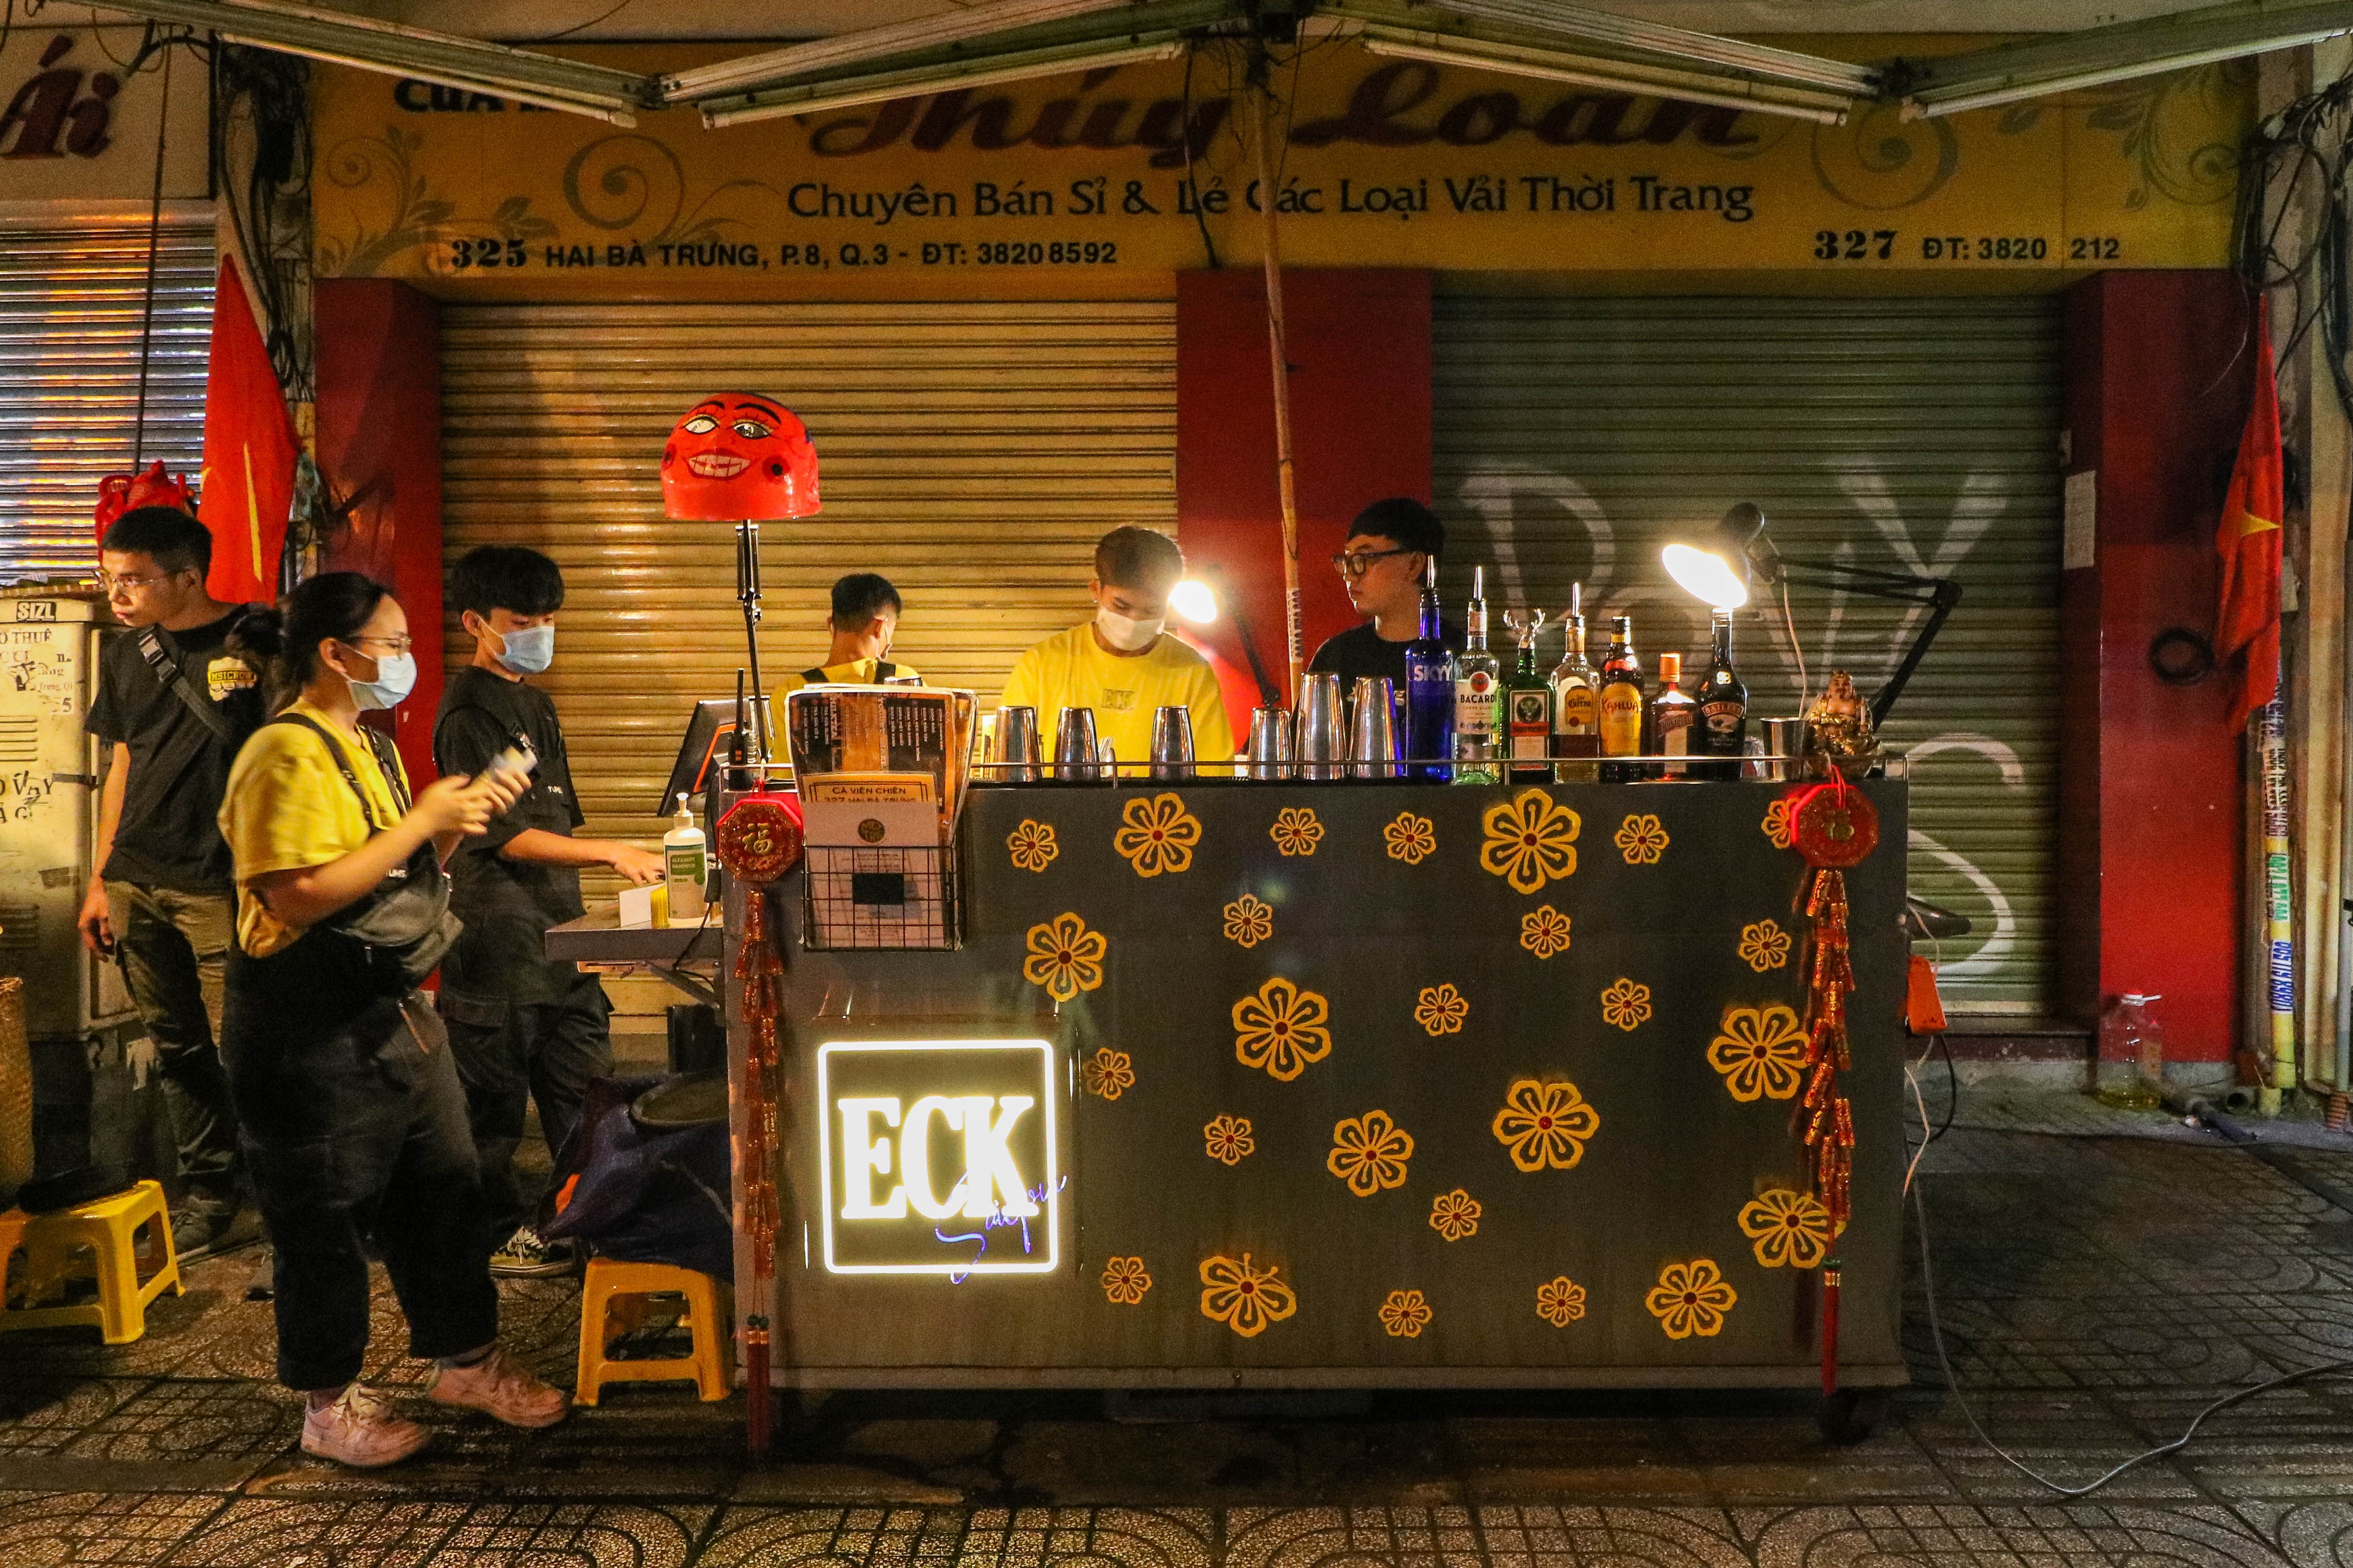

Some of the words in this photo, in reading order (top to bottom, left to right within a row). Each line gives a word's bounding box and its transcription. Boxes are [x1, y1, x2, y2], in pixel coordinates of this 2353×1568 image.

[789, 183, 957, 225] Chuyên
[975, 180, 1052, 216] Bán
[1069, 176, 1106, 215] Sỉ
[1123, 180, 1161, 215] &
[1177, 176, 1228, 214] Lẻ
[1340, 178, 1429, 220] Loại
[1444, 174, 1506, 213] Vải
[1520, 173, 1615, 213] Thời
[1629, 175, 1754, 223] Trang
[452, 238, 527, 268] 325
[546, 245, 594, 267] HAI
[607, 239, 646, 267] BÀ
[839, 243, 889, 267] Q.3
[921, 242, 967, 265] ĐT:
[1814, 230, 1898, 261] 327
[1923, 238, 1969, 260] ĐT:
[1979, 237, 2046, 261] 3820
[2070, 238, 2121, 260] 212
[838, 1095, 1039, 1219] ECK
